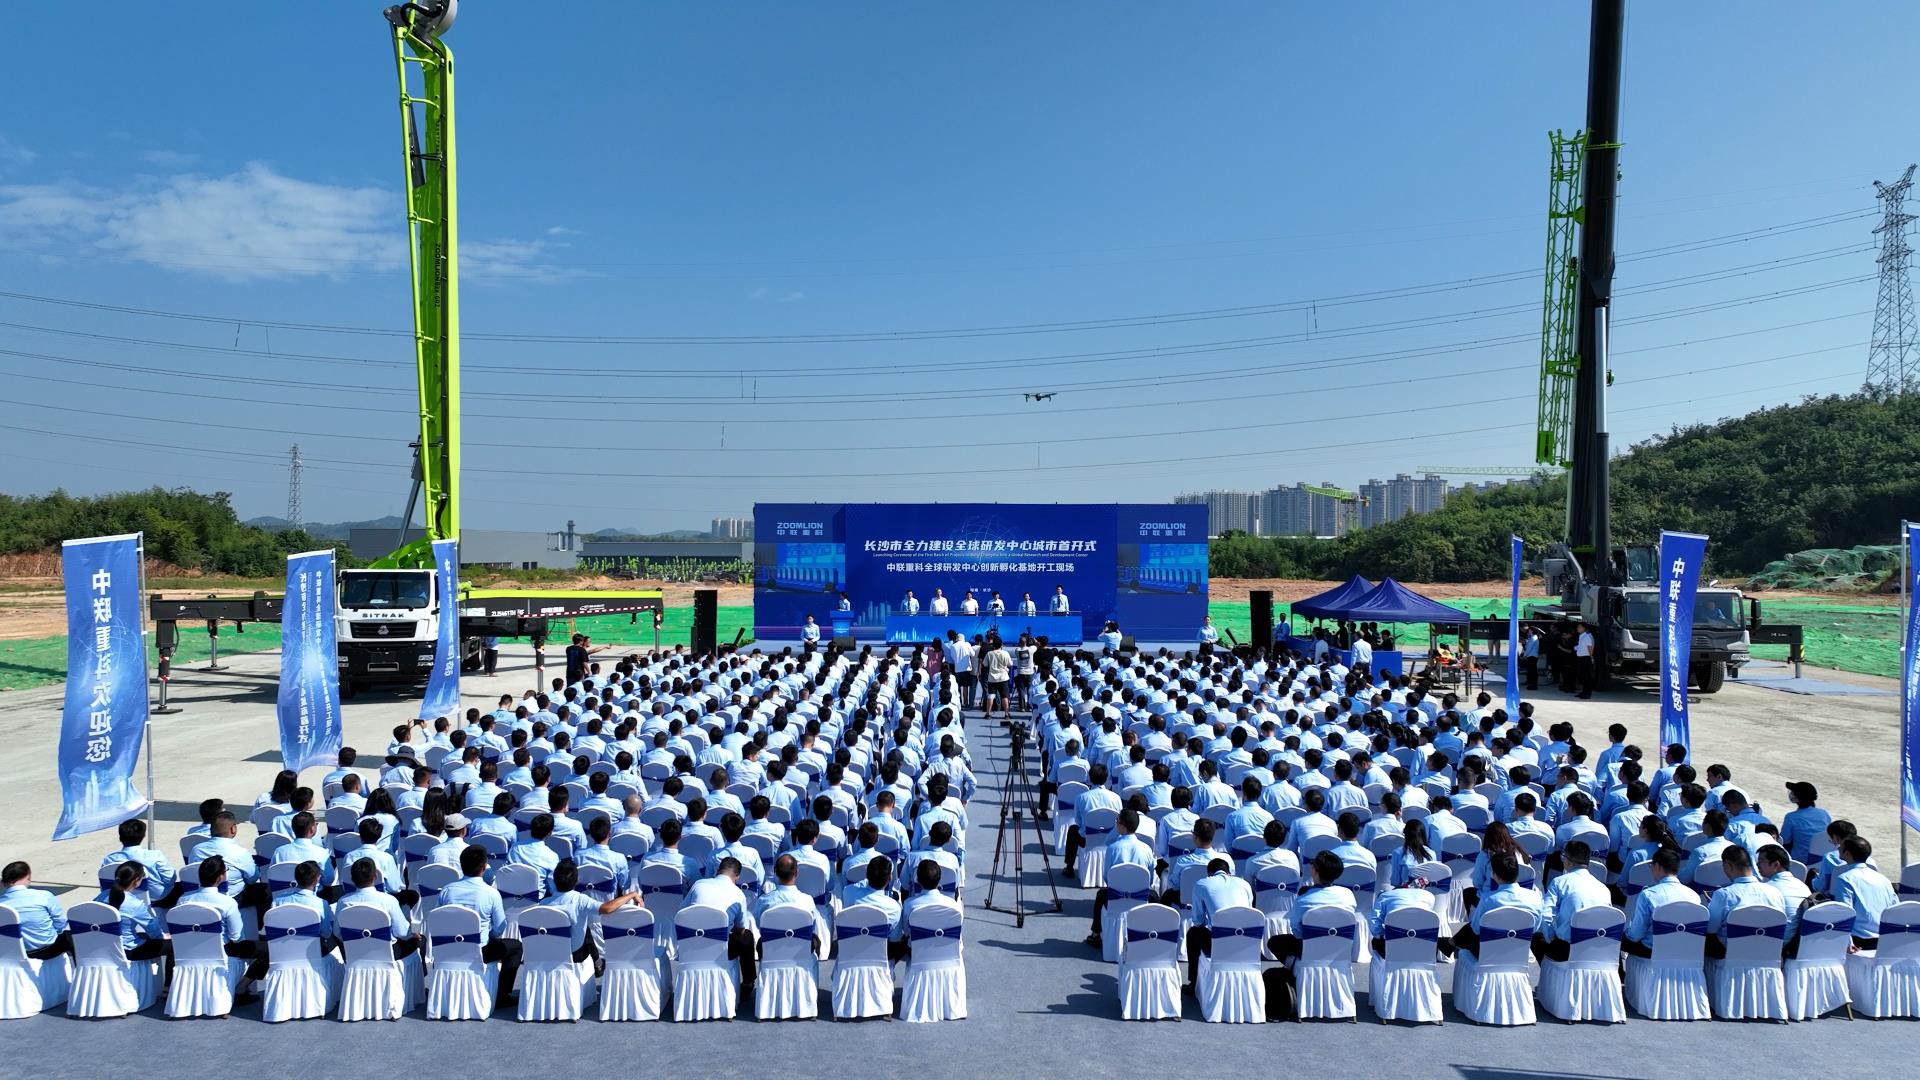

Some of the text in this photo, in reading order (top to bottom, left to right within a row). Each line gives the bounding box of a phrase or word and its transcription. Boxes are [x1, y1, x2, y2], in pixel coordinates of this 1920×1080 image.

[864, 540, 1096, 551] 长沙市全力建设全球研发中心城市首开式
[886, 562, 1074, 572] 中联重科全球研发中心创新孵化基地开工现场
[1668, 557, 1686, 712] 中联重科欢迎您
